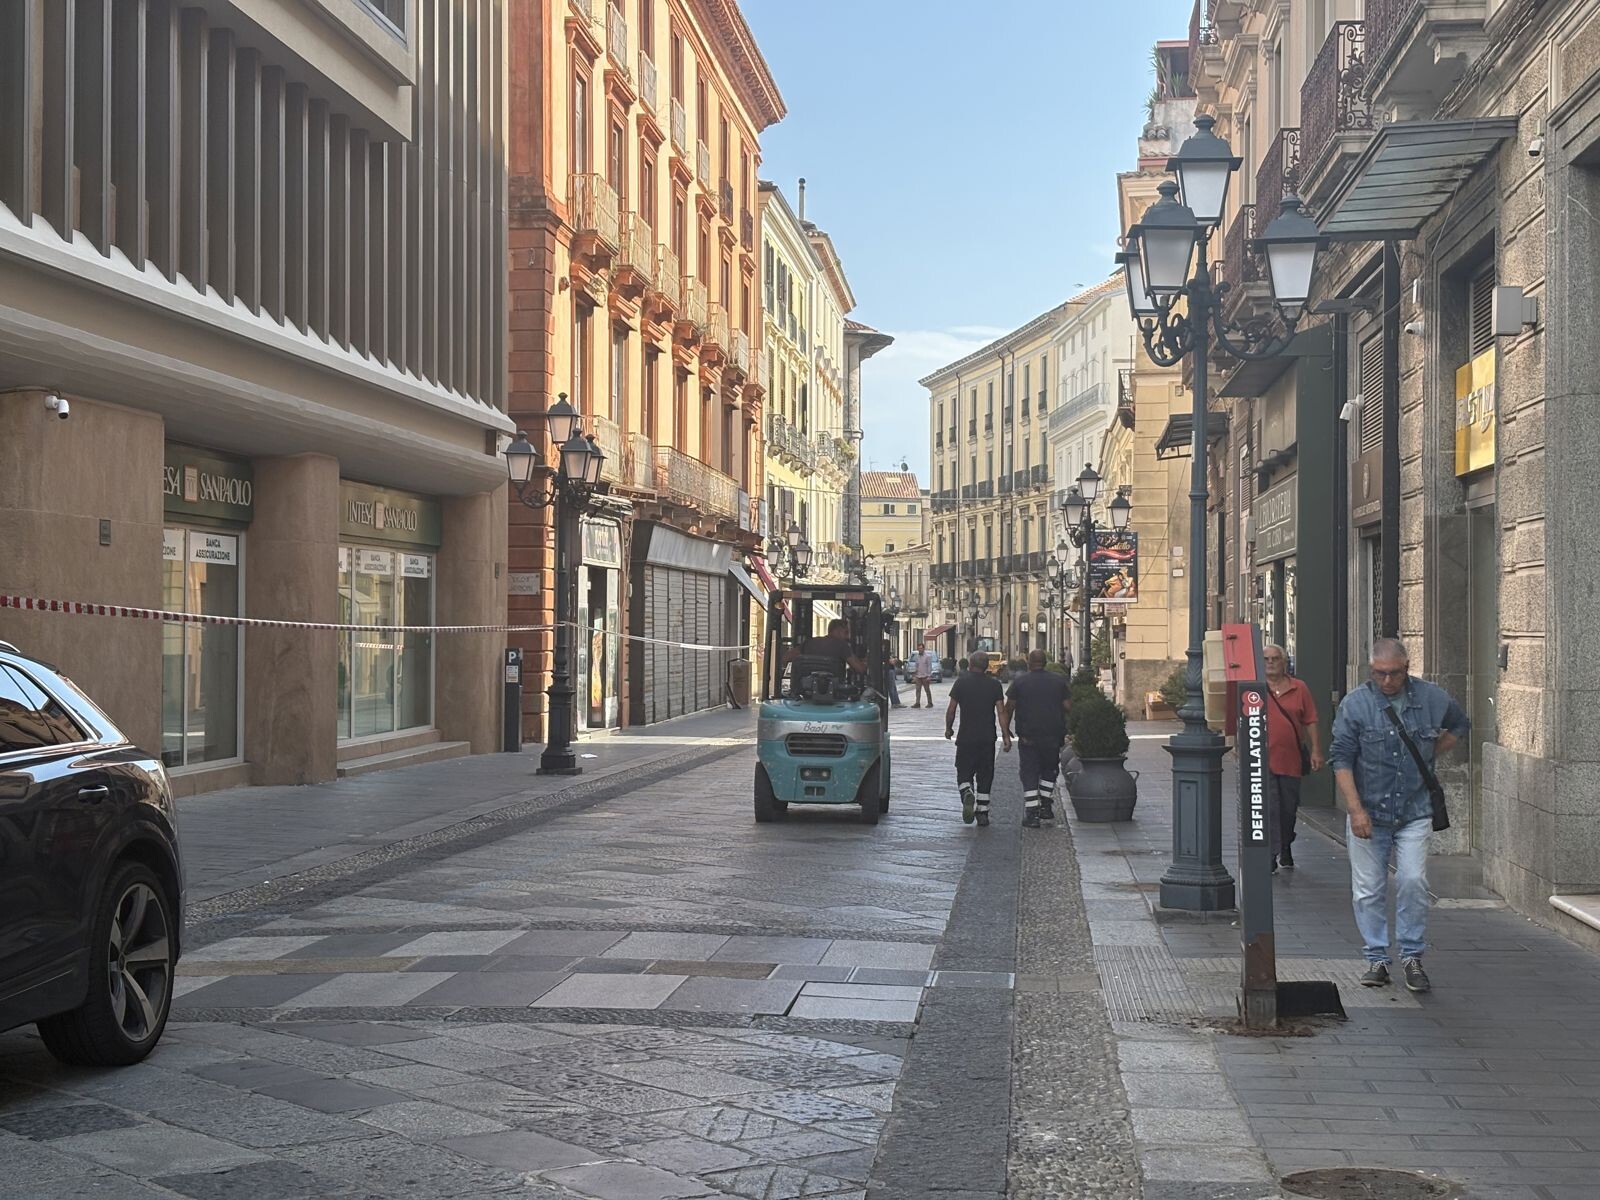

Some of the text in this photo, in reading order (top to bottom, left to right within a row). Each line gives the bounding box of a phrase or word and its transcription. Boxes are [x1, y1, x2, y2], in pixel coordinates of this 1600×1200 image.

[163, 466, 252, 506] ESA SANPAOLO
[347, 499, 418, 532] INTESA SANPAOLO
[205, 537, 221, 548] BANCA
[195, 548, 231, 561] ASSICURAZIONE
[508, 651, 517, 663] P
[1248, 706, 1264, 841] DEFIBRILLATORE
